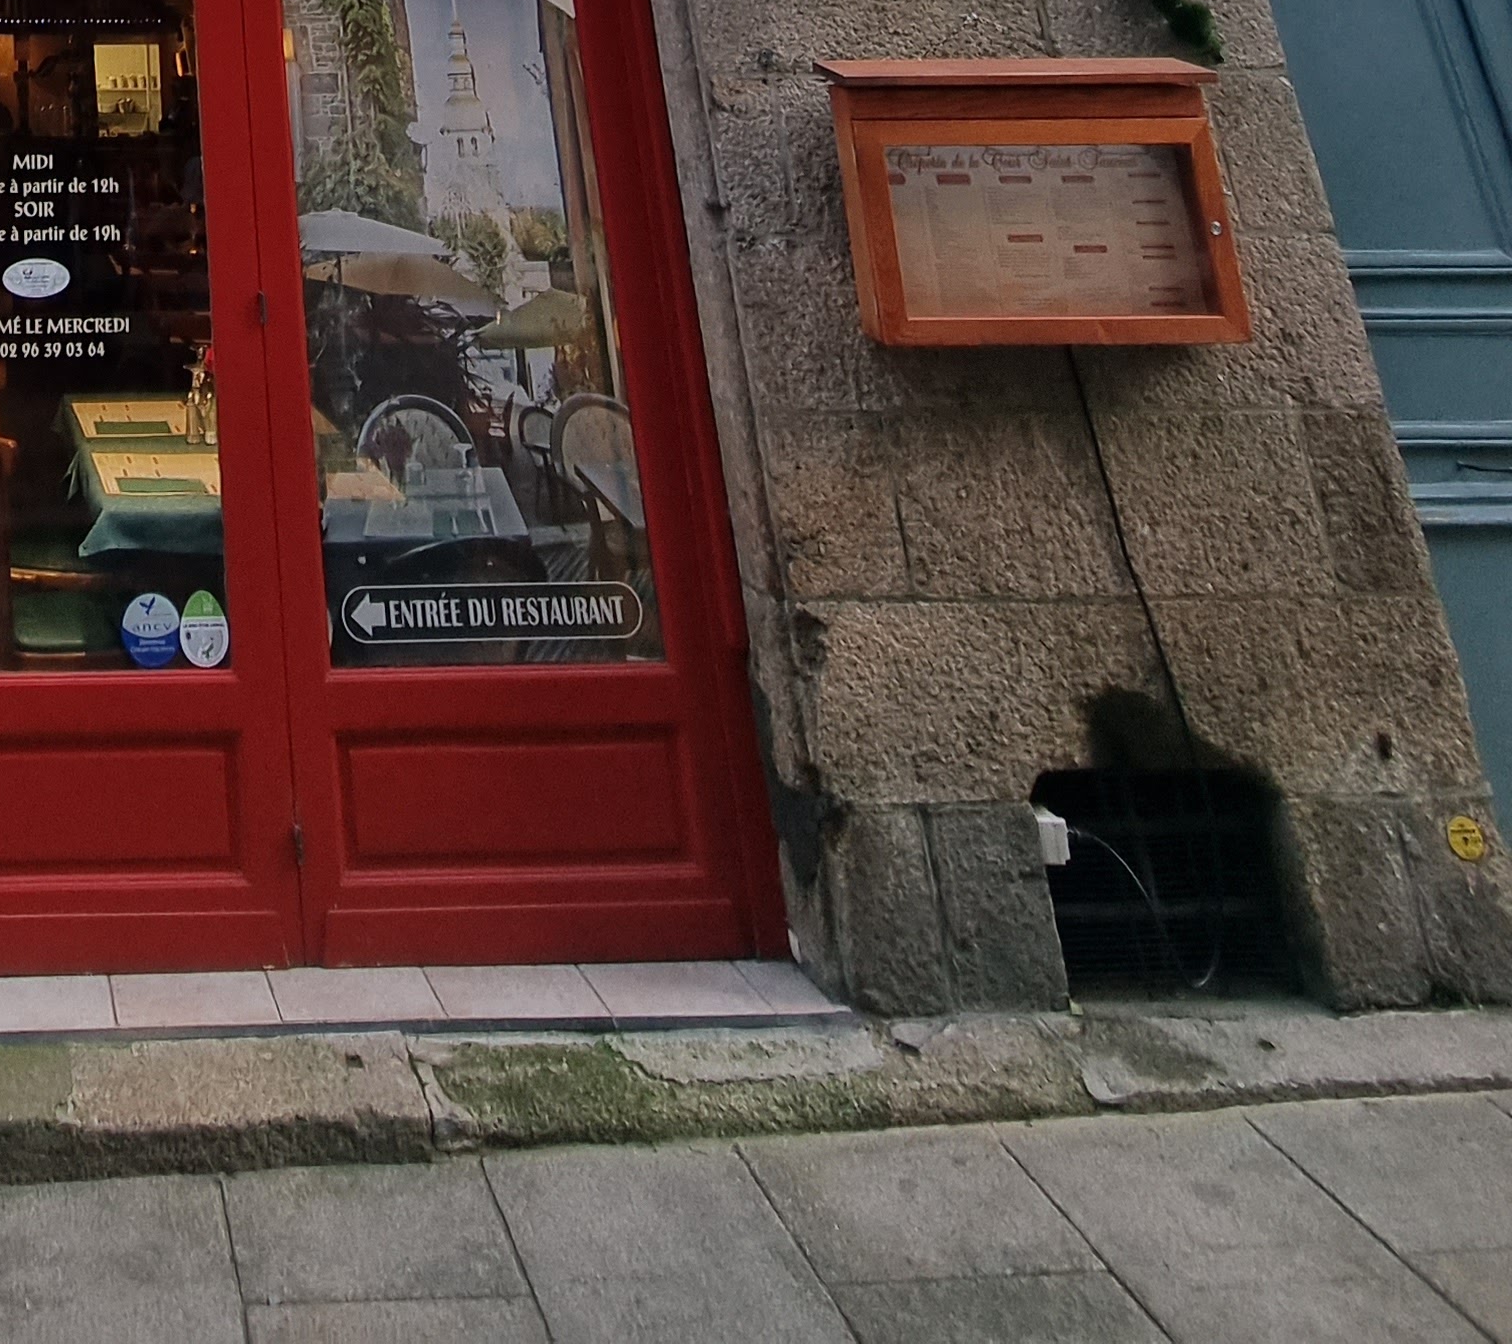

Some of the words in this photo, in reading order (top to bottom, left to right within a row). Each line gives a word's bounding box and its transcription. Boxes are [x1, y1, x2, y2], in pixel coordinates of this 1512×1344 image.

[12, 154, 54, 171] MIDI
[9, 178, 19, 194] à
[22, 178, 64, 198] partir
[67, 176, 88, 194] de
[90, 176, 120, 194] 12h
[13, 201, 55, 218] SOIR
[10, 225, 20, 242] à
[23, 225, 66, 246] partir
[68, 223, 89, 242] de
[92, 223, 121, 242] 19h
[25, 318, 44, 335] LE
[46, 316, 131, 335] MERCREDI
[0, 341, 18, 359] 02
[21, 341, 40, 359] 96
[43, 341, 63, 359] 39
[65, 341, 84, 358] 03
[87, 340, 106, 358] 64
[389, 591, 464, 629] ENTRÉE
[467, 597, 496, 627] DU
[501, 595, 625, 627] RESTAURANT
